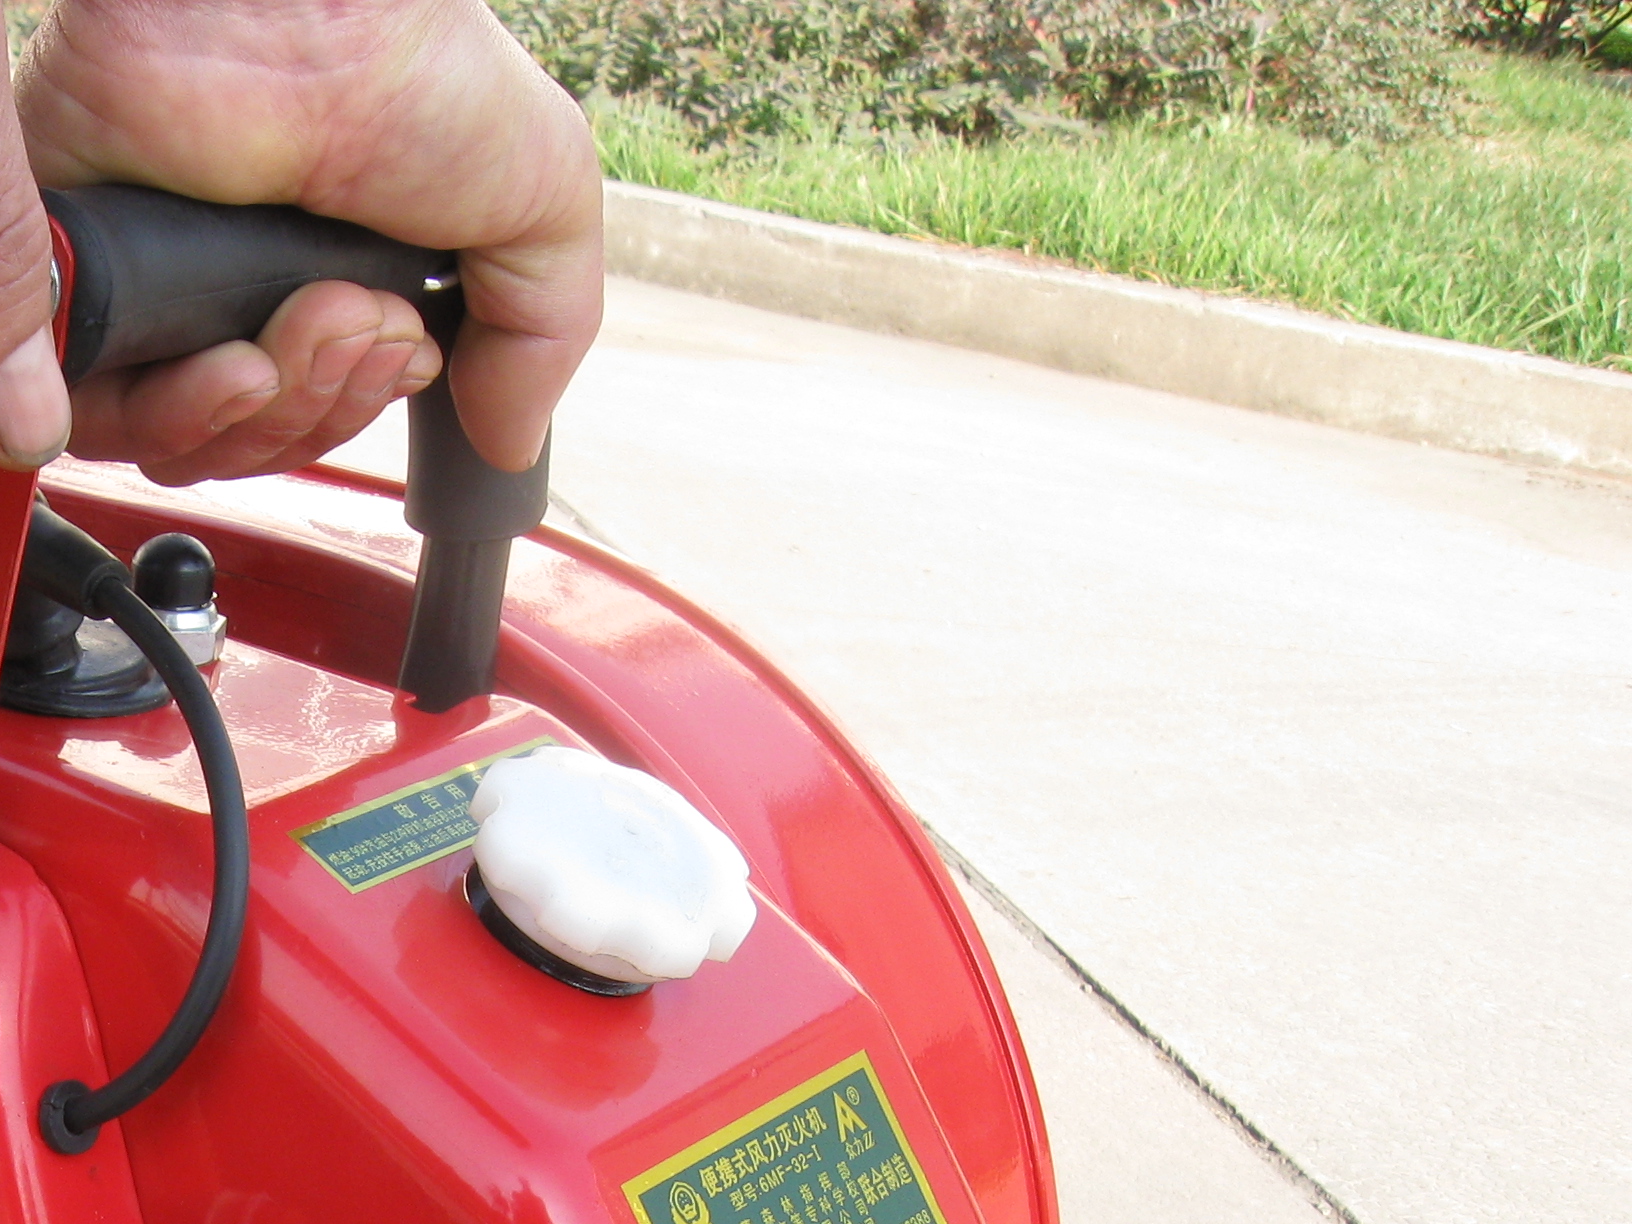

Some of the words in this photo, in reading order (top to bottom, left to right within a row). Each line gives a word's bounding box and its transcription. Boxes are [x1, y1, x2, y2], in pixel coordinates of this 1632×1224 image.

[700, 1107, 826, 1197] 便携式风力灭火机
[858, 1153, 912, 1205] 联合制造
